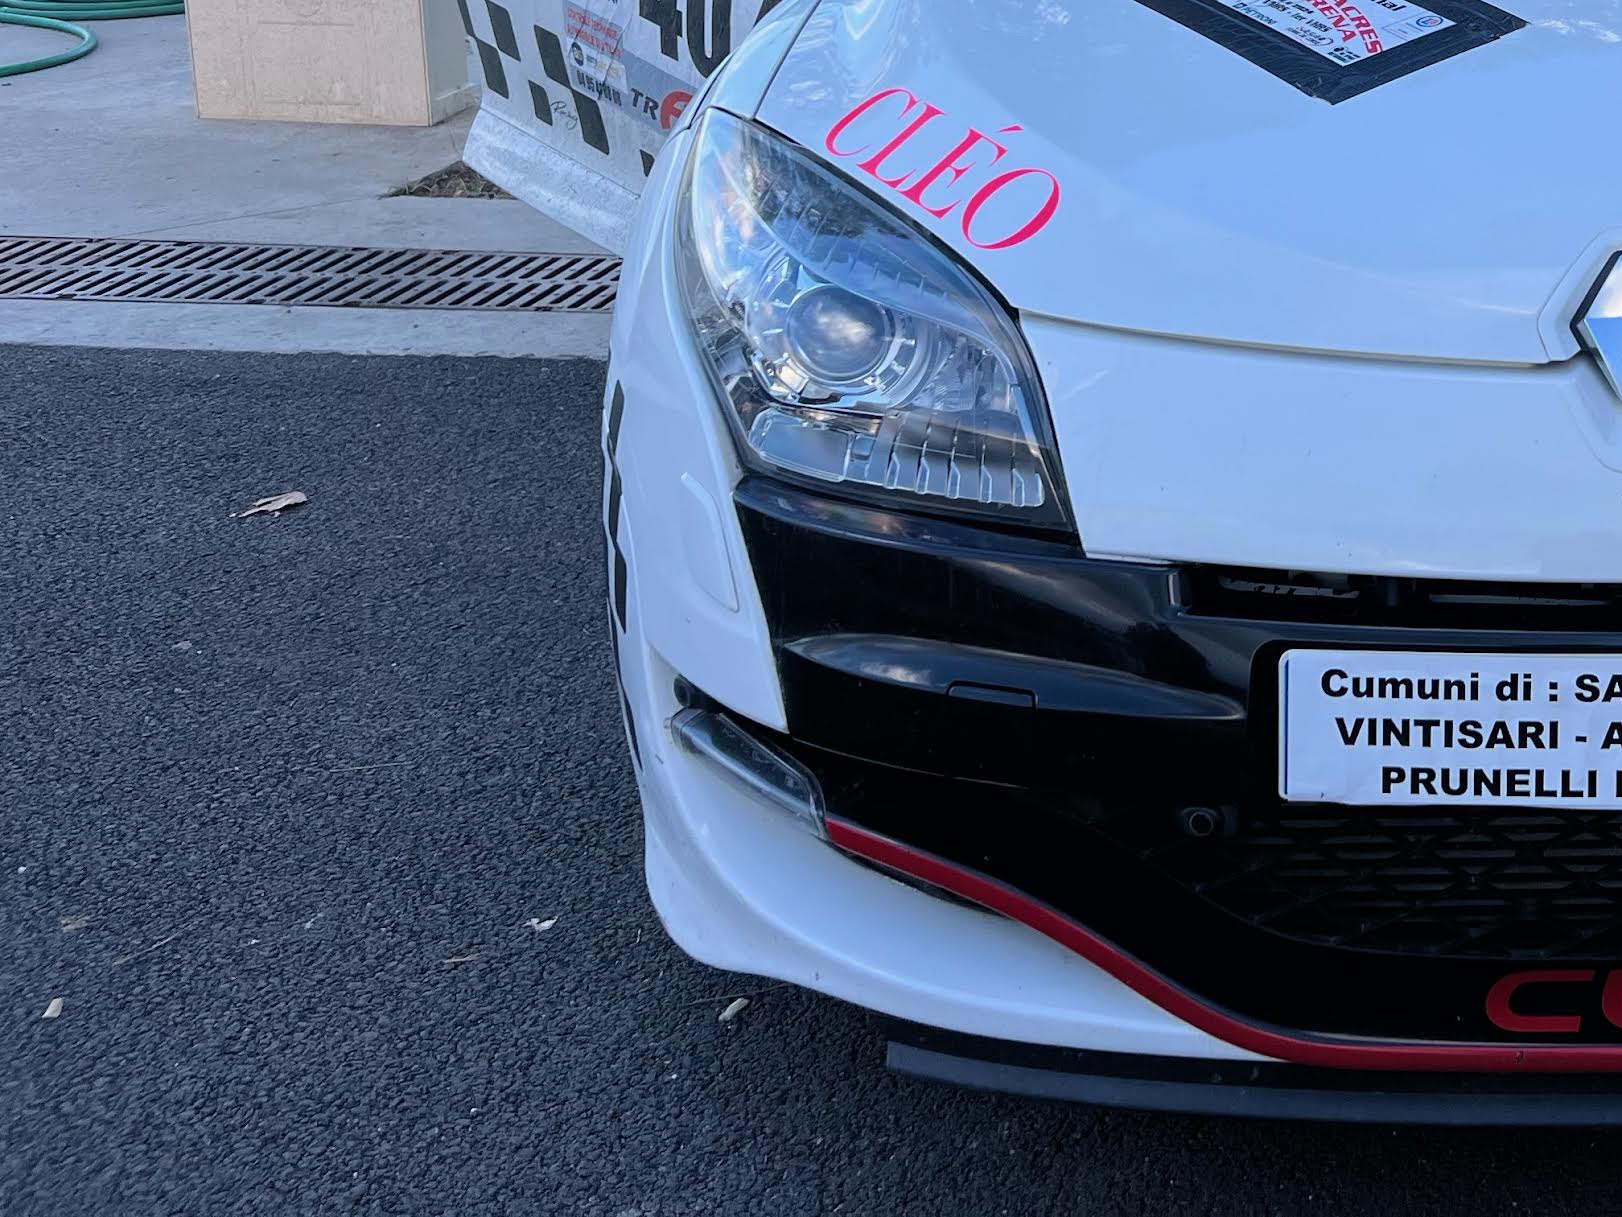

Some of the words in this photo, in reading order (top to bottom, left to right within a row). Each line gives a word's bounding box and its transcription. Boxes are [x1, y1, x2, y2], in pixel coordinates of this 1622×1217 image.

[824, 87, 1061, 250] CLÉO
[1319, 667, 1481, 703] Cumuni
[1494, 671, 1533, 703] di
[1547, 678, 1560, 703] :
[1334, 716, 1560, 751] VINTISARI
[1381, 765, 1598, 798] PRUNELLI
